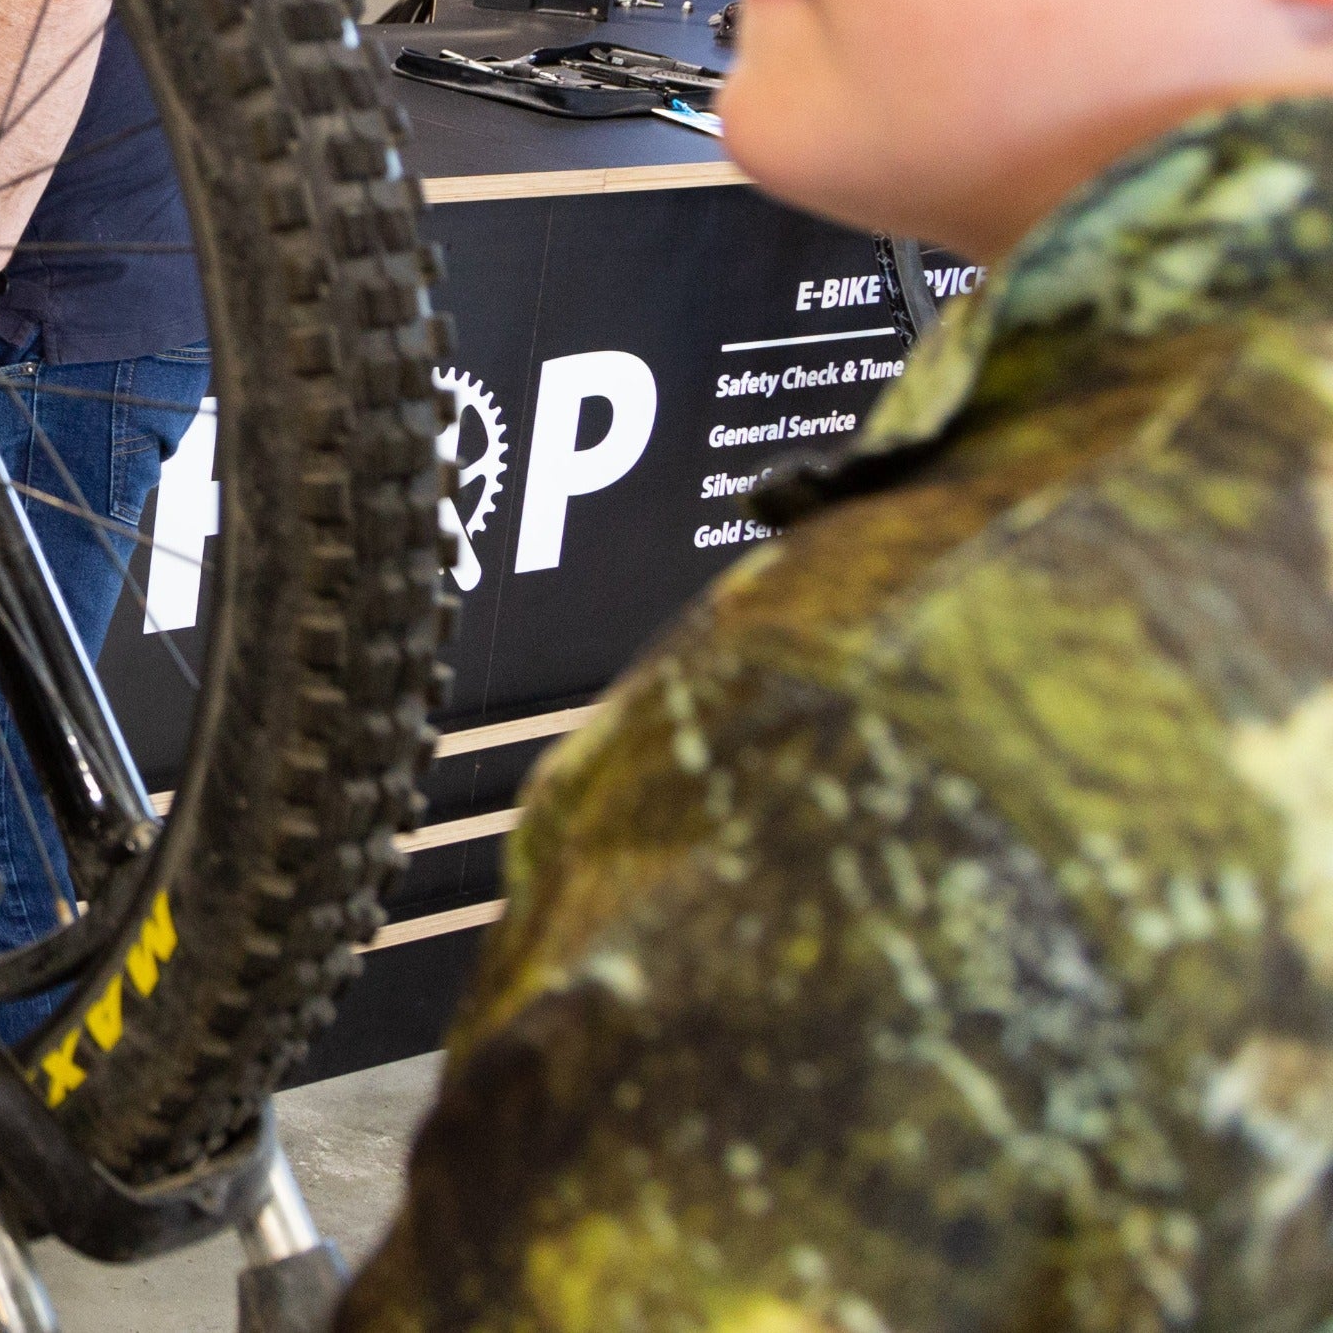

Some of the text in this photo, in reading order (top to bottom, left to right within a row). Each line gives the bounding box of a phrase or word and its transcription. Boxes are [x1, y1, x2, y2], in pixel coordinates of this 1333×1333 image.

[795, 275, 881, 311] E-BIKE
[716, 358, 904, 398] Safety Check & Tune
[709, 410, 856, 447] General Service
[701, 472, 757, 499] Silver
[694, 520, 740, 548] Gold
